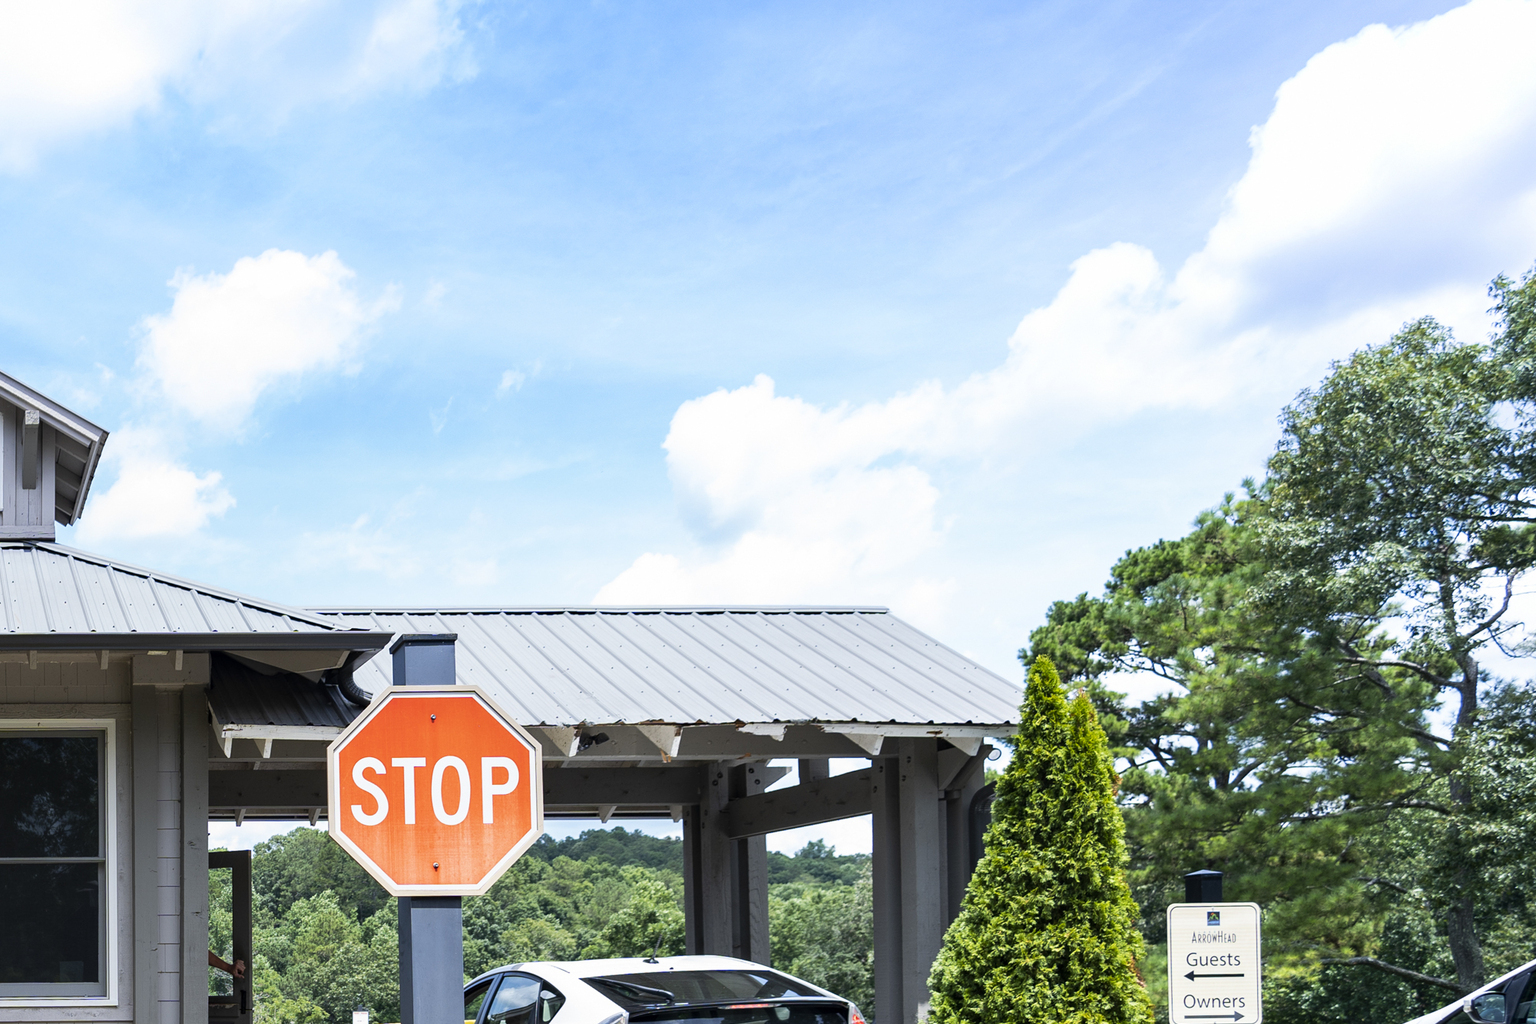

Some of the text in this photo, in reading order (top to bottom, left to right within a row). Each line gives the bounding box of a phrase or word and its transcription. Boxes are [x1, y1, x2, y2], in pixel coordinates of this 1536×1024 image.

[350, 755, 520, 826] STOP
[1186, 952, 1241, 967] Guests
[1183, 994, 1246, 1009] Owners
